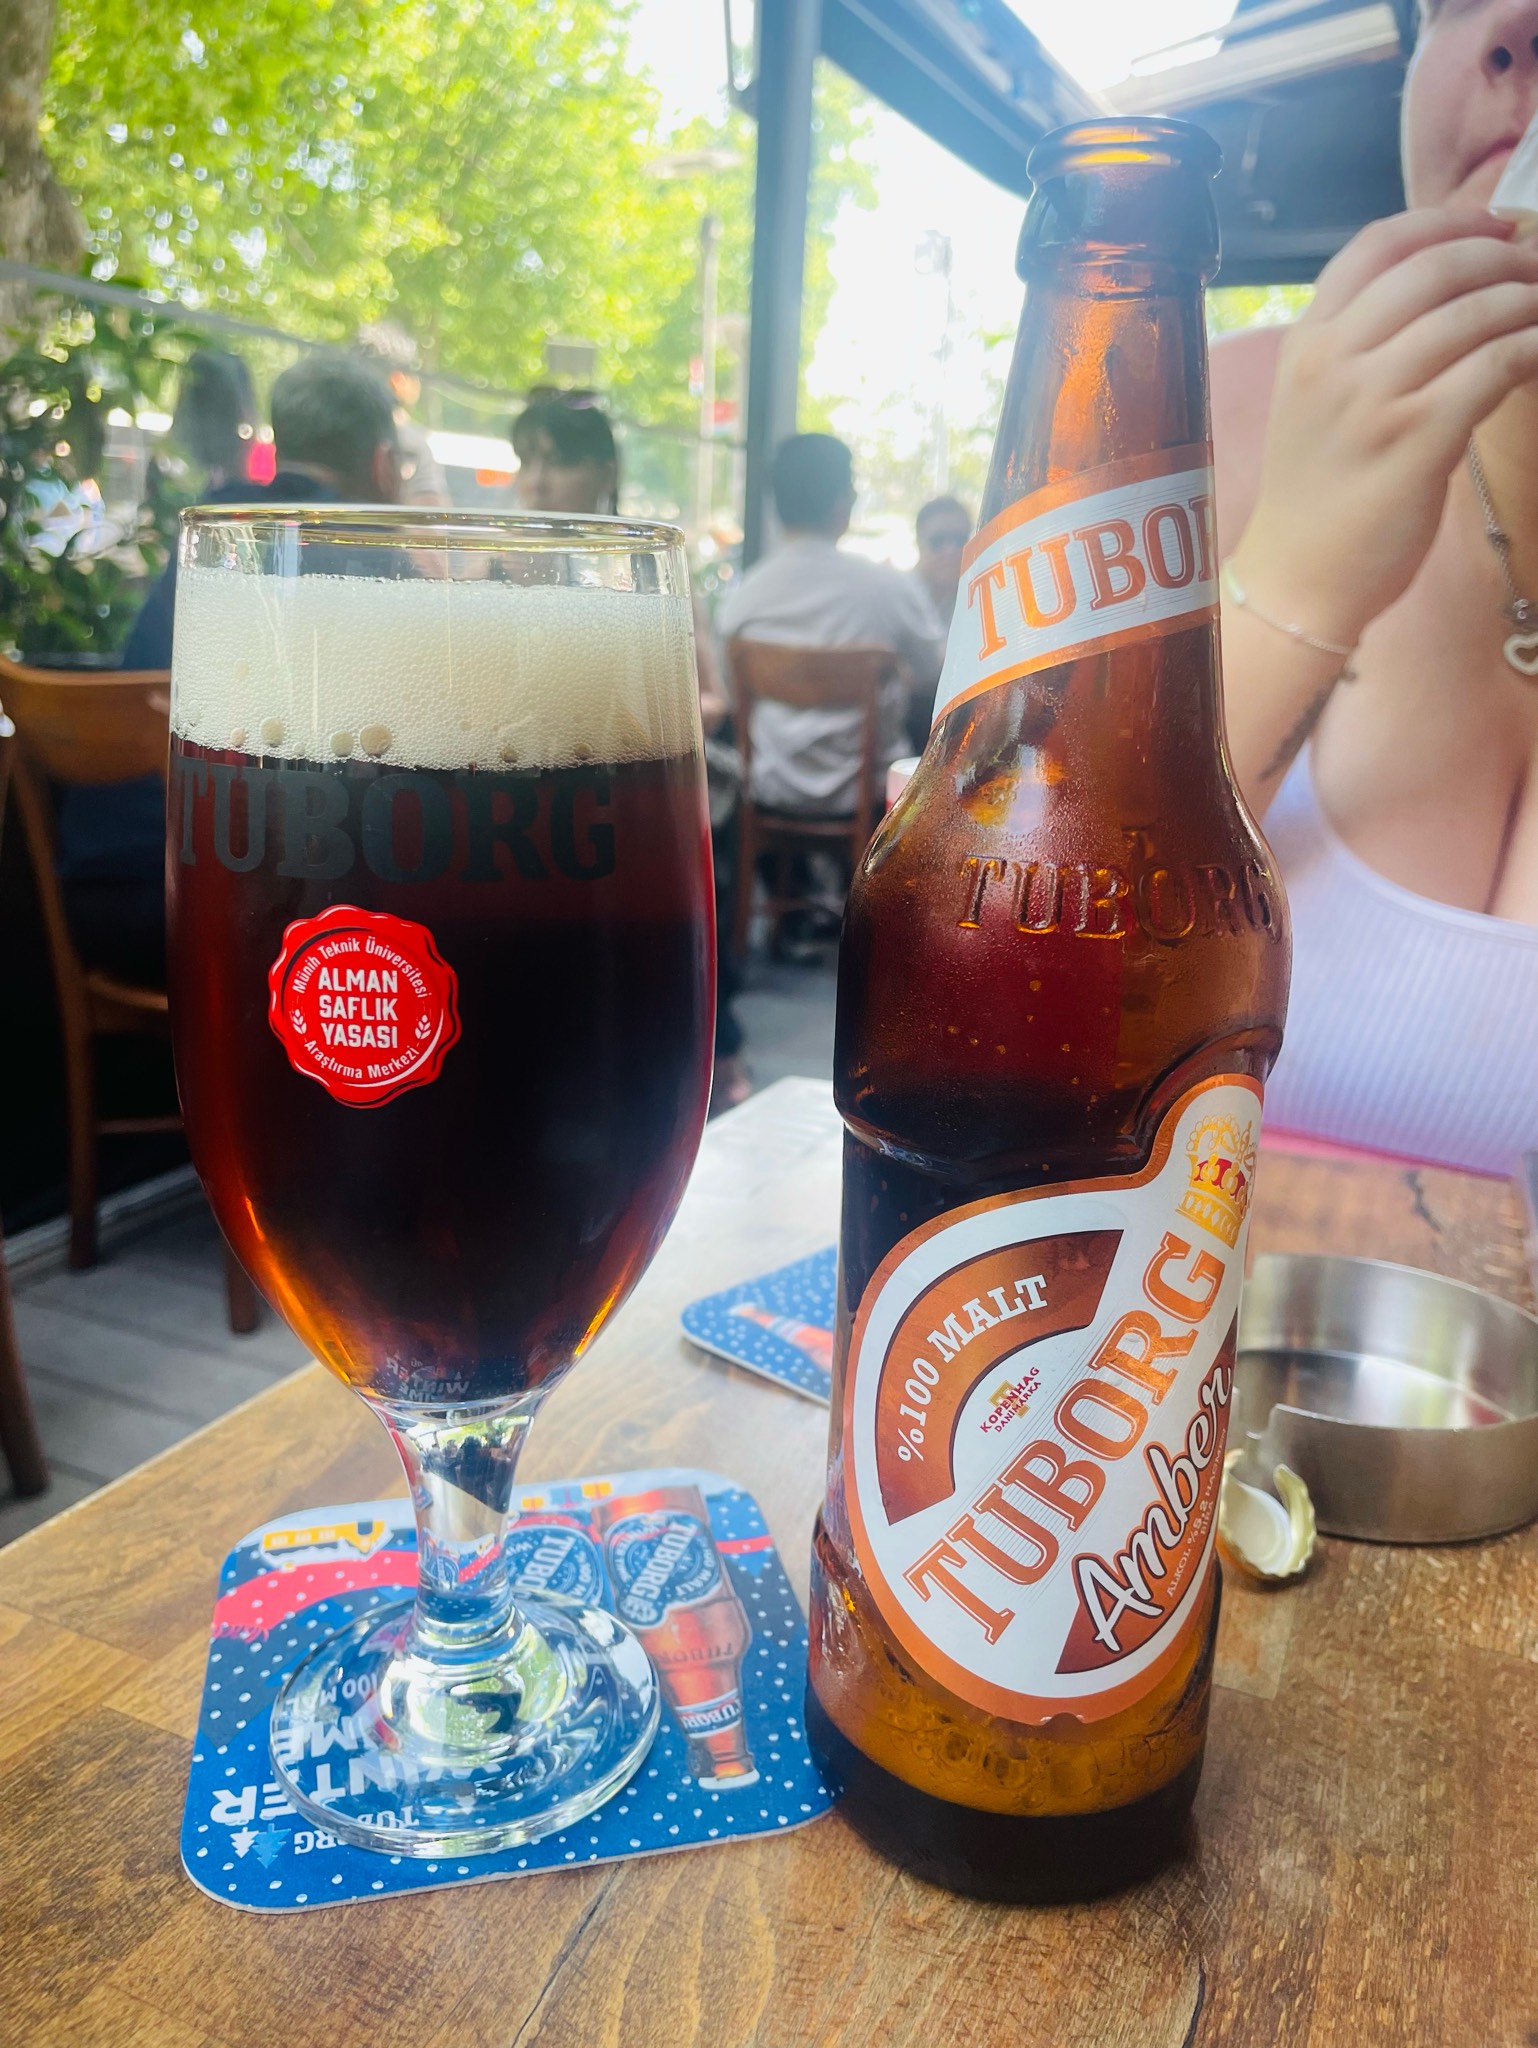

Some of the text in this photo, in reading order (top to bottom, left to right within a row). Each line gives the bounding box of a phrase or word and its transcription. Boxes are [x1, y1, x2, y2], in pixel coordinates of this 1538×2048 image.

[176, 756, 616, 884] TUBORG
[292, 936, 432, 998] Münih Teknik Üniversitesi
[318, 967, 398, 993] ALMAN
[319, 995, 399, 1021] SAFLIK
[320, 1023, 398, 1049] YASASI
[305, 1039, 419, 1080] Araştırma Merkezi
[896, 1274, 1048, 1464] %100 MALT
[980, 1367, 1040, 1433] KOPENHAG
[902, 1231, 1225, 1646] TUBORG
[1075, 1366, 1233, 1653] Amber
[629, 1521, 698, 1601] TUBORG
[675, 1569, 713, 1597] MALT
[1167, 1549, 1192, 1597] ALKOL
